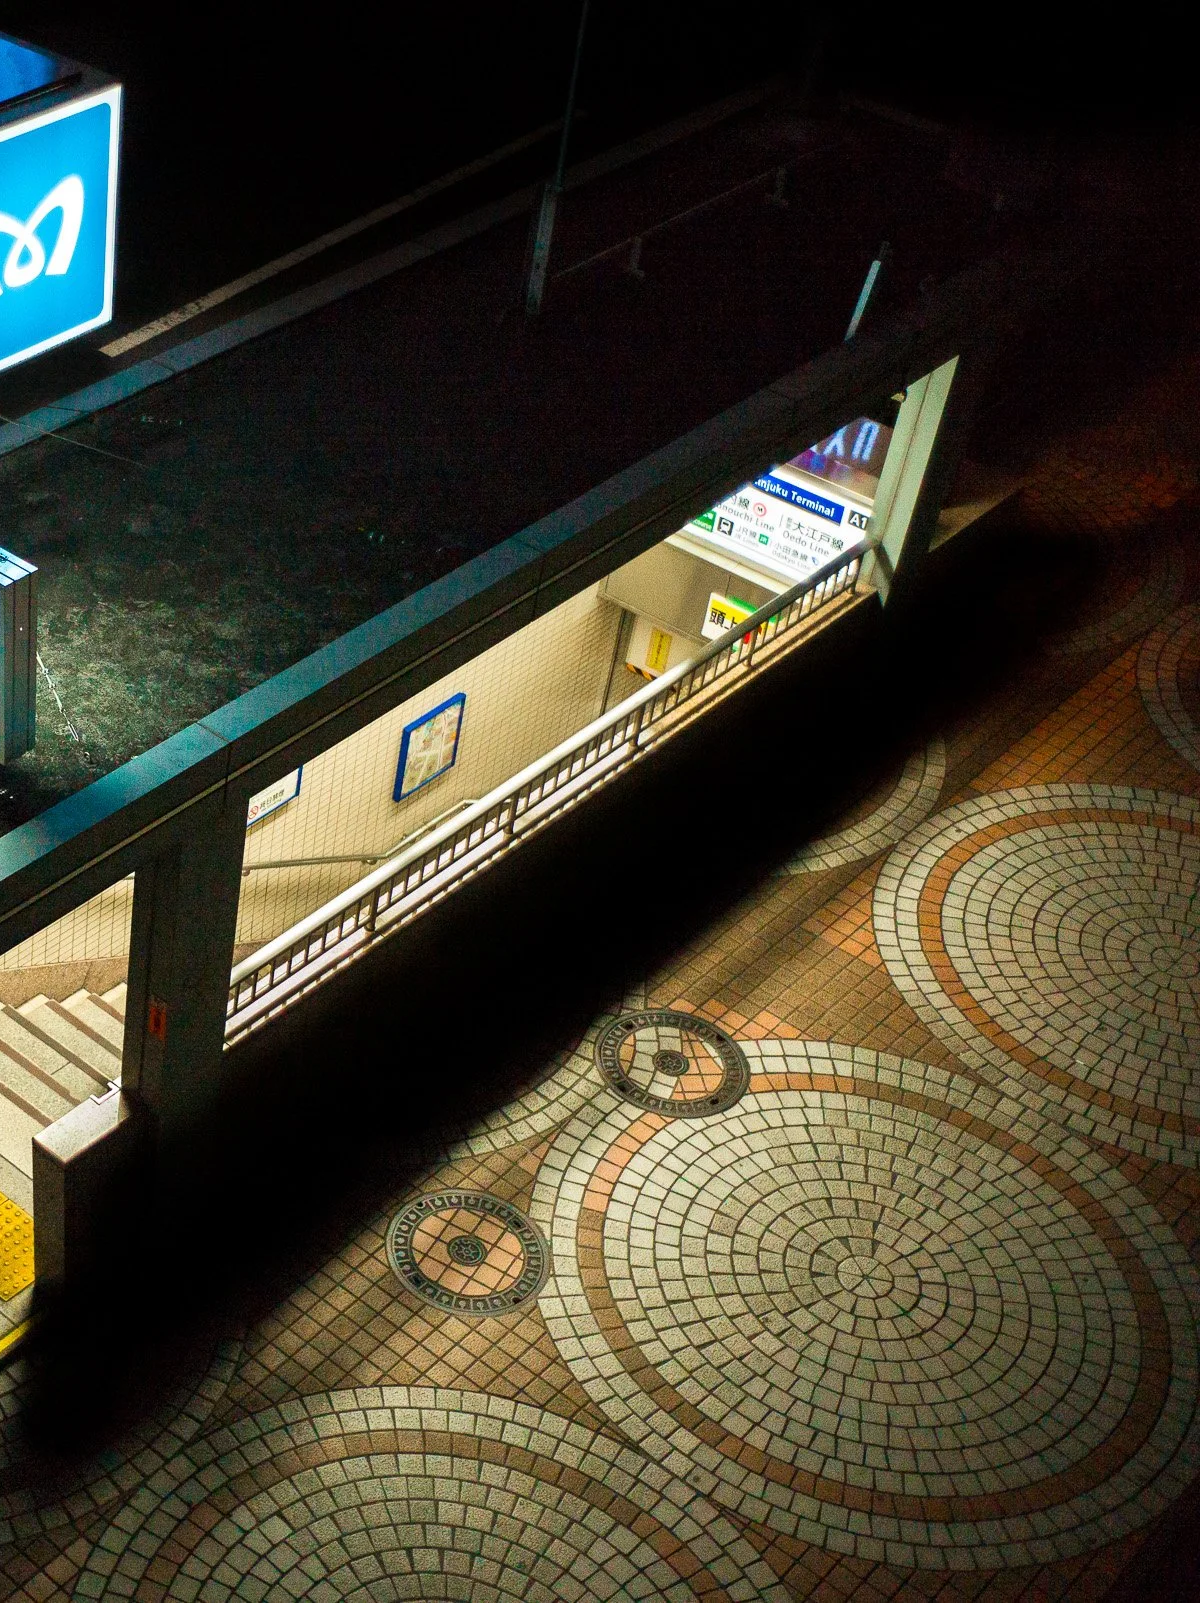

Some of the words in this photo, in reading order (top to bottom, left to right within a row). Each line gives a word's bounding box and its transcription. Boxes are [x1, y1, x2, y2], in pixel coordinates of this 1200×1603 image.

[791, 489, 835, 518] Terminal
[754, 517, 775, 532] Line
[849, 512, 867, 529] A1
[782, 530, 807, 547] Oedo
[809, 541, 830, 557] Line
[793, 521, 844, 551] 大江戸線
